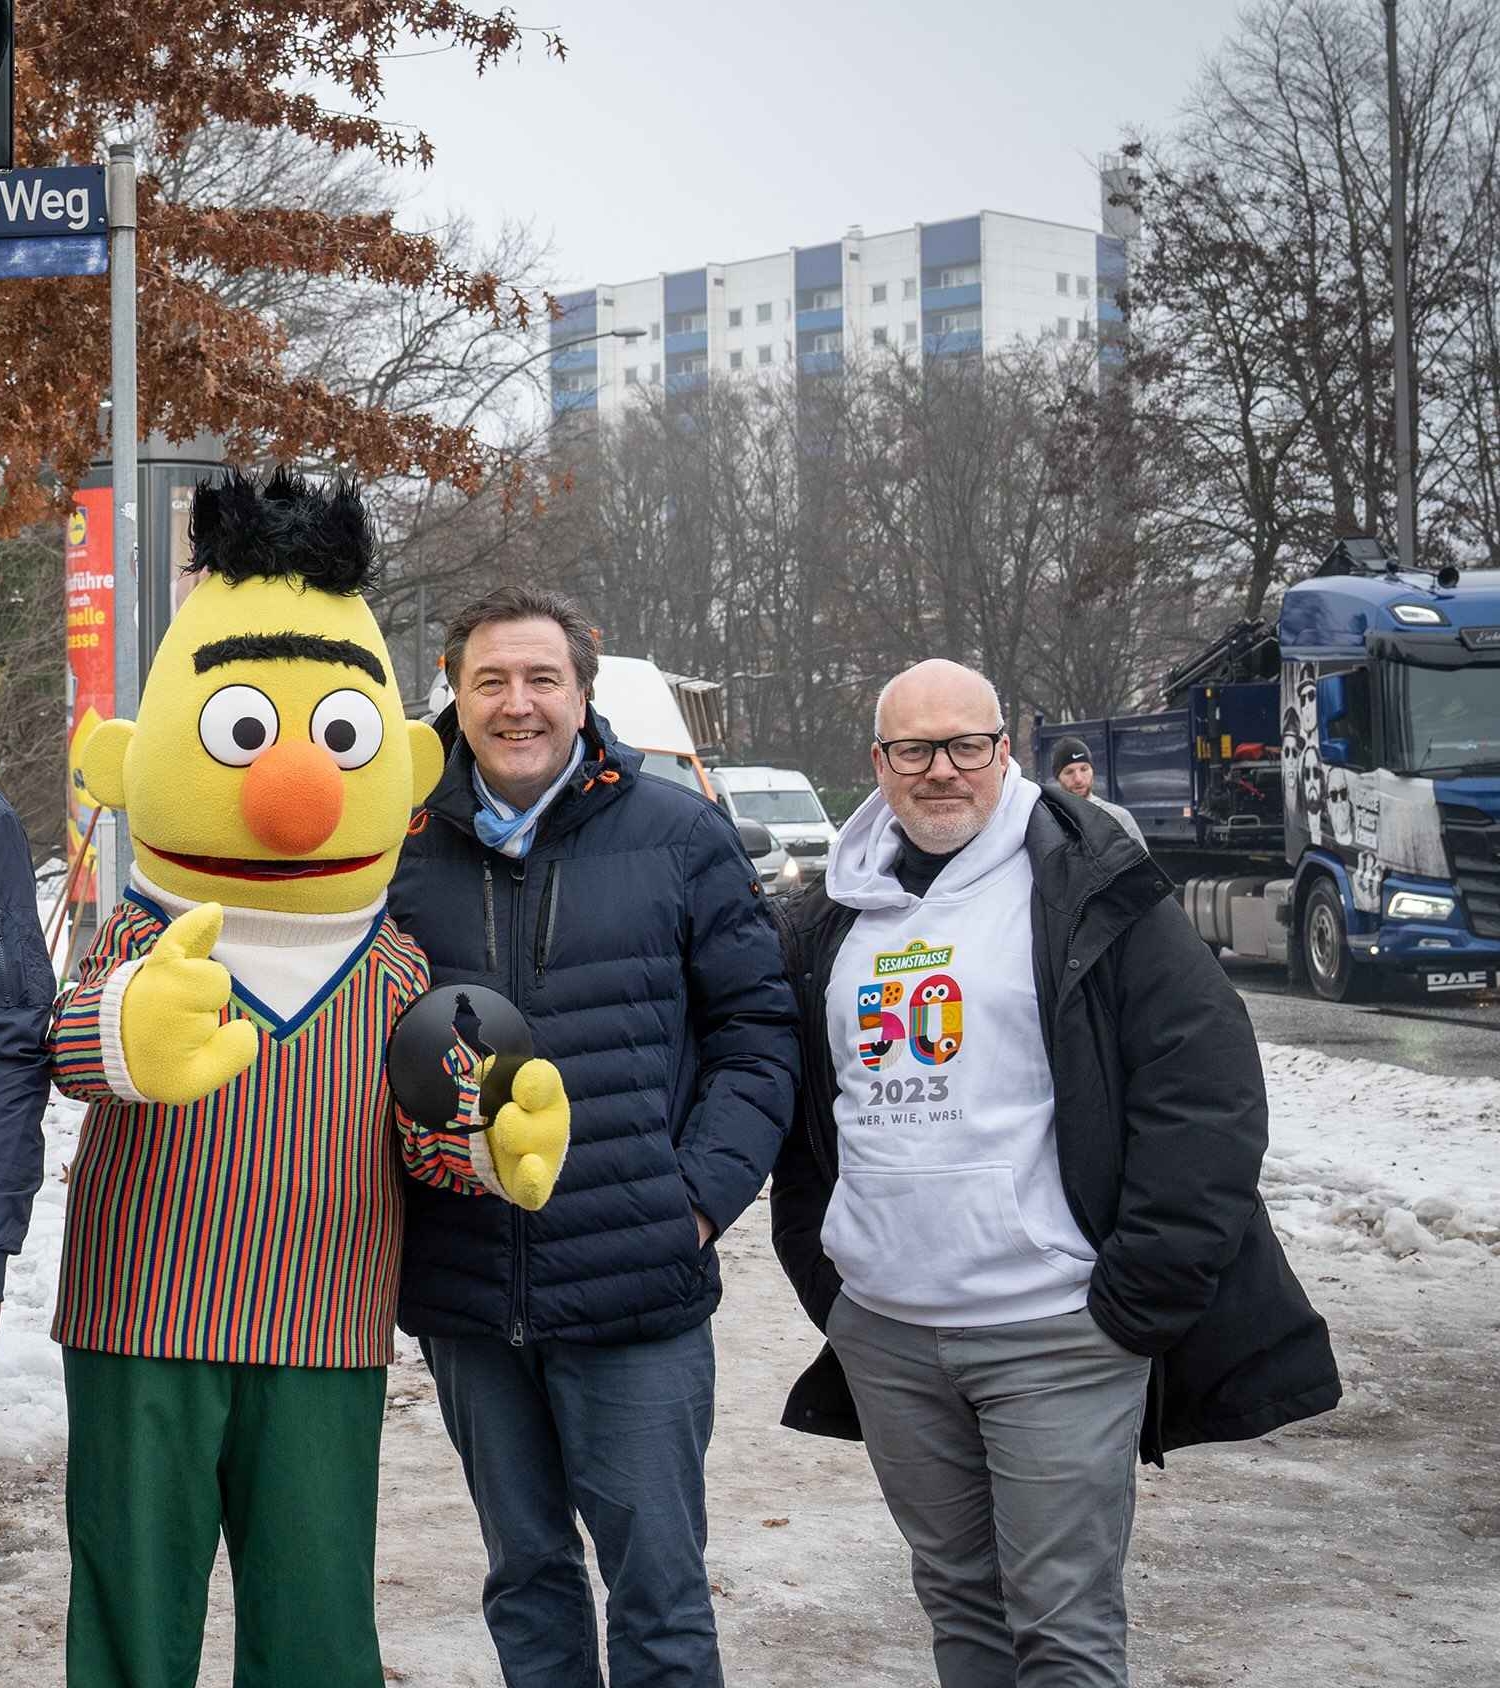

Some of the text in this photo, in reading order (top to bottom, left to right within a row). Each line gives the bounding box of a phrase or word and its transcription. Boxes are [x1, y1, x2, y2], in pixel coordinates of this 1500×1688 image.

[878, 950, 949, 972] SESAMSTRASSE
[1427, 971, 1487, 986] DAF
[857, 974, 963, 1071] 50
[868, 1075, 948, 1106] 2023
[858, 1108, 962, 1126] WER, WIE, WAS!
